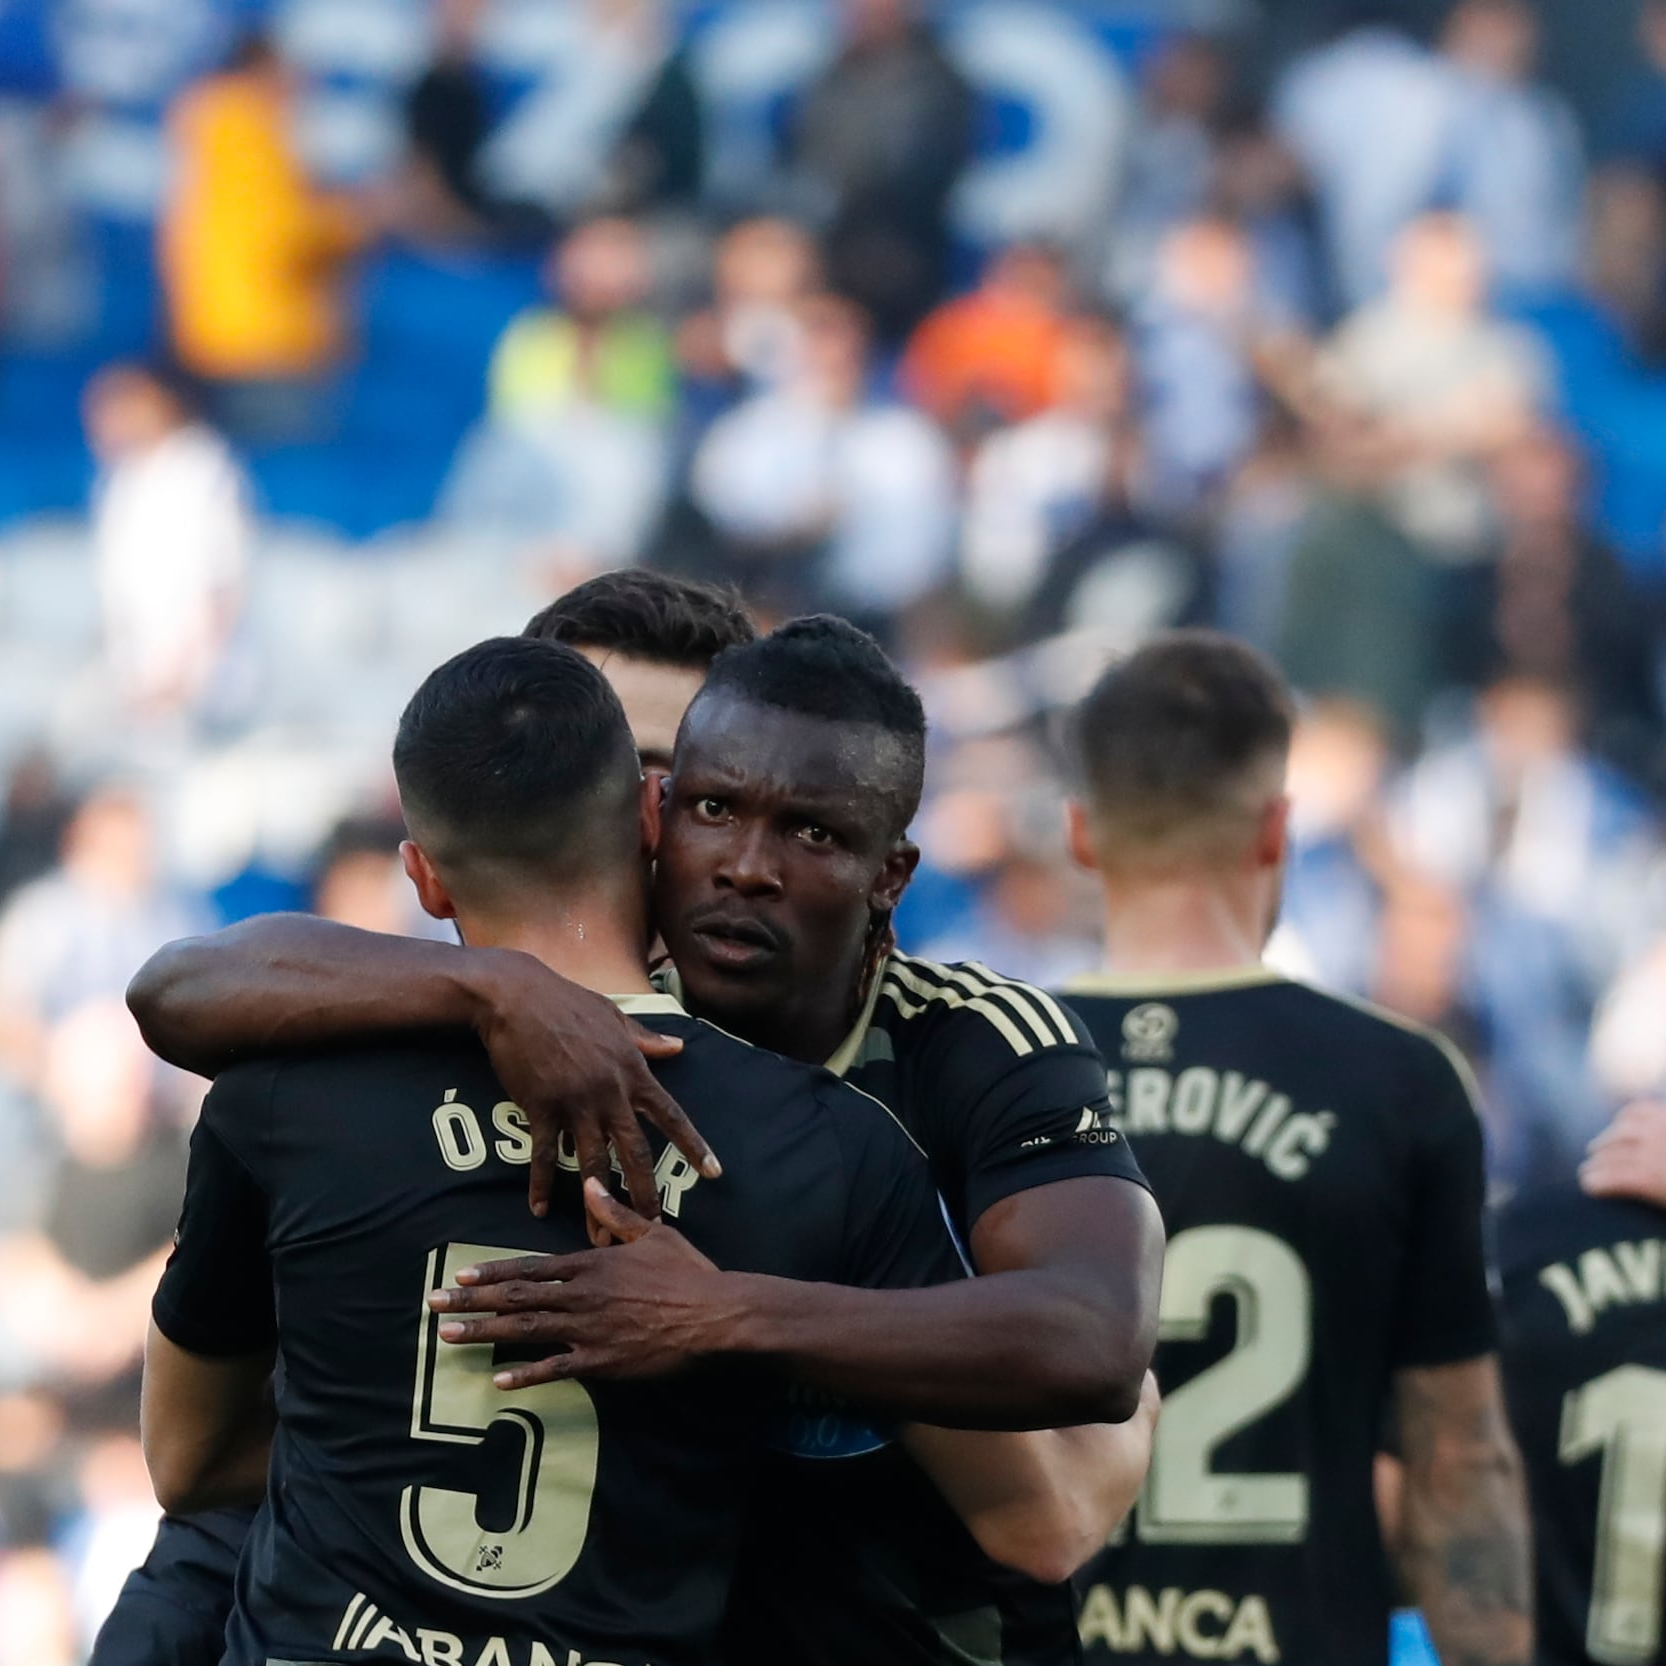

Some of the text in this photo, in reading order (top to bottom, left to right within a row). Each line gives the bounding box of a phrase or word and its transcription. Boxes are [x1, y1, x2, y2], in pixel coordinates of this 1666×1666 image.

[433, 1088, 700, 1218] ÓSR
[1072, 1131, 1118, 1145] ROUP
[400, 1242, 600, 1600] 5
[1111, 1224, 1312, 1546] 2
[1077, 1582, 1281, 1666] ANCA
